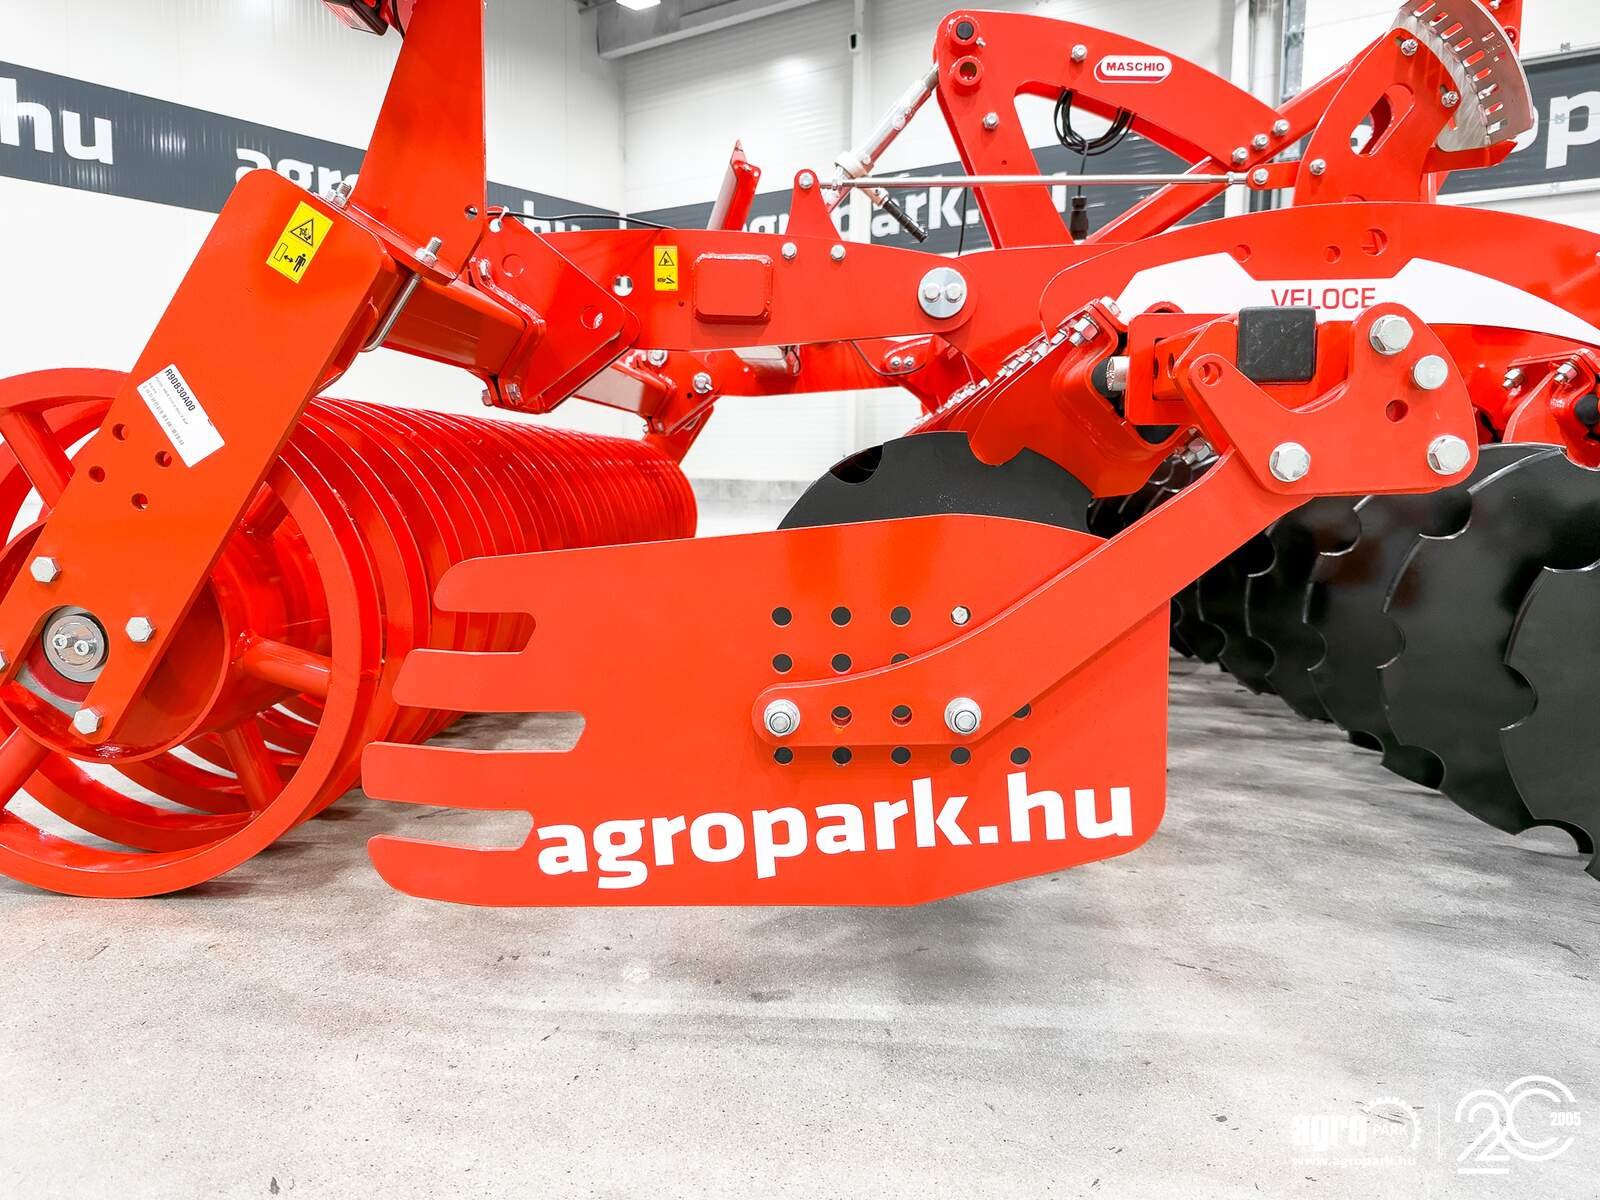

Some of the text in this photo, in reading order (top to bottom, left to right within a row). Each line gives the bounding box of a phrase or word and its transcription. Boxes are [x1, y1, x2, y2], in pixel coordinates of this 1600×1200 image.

[1106, 62, 1165, 72] MASCHIO
[1271, 288, 1376, 310] VELOCE
[536, 772, 1133, 889] agropark.hu
